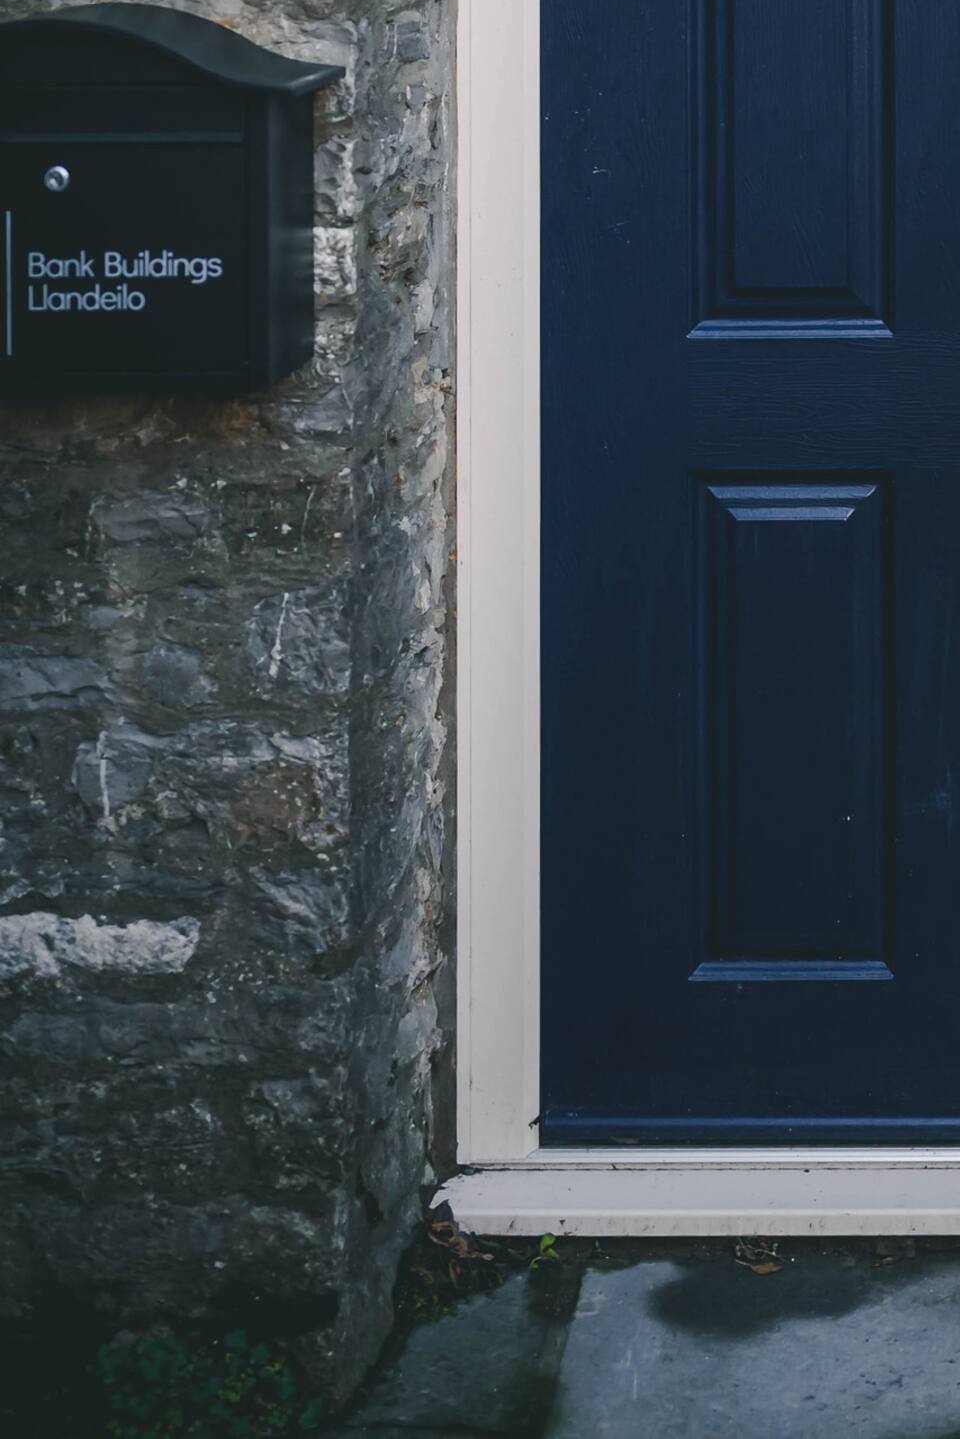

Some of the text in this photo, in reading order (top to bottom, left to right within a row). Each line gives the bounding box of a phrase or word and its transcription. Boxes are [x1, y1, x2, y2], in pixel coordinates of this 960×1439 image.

[28, 250, 223, 284] Bank Buildings
[28, 283, 146, 311] Llandeilo
